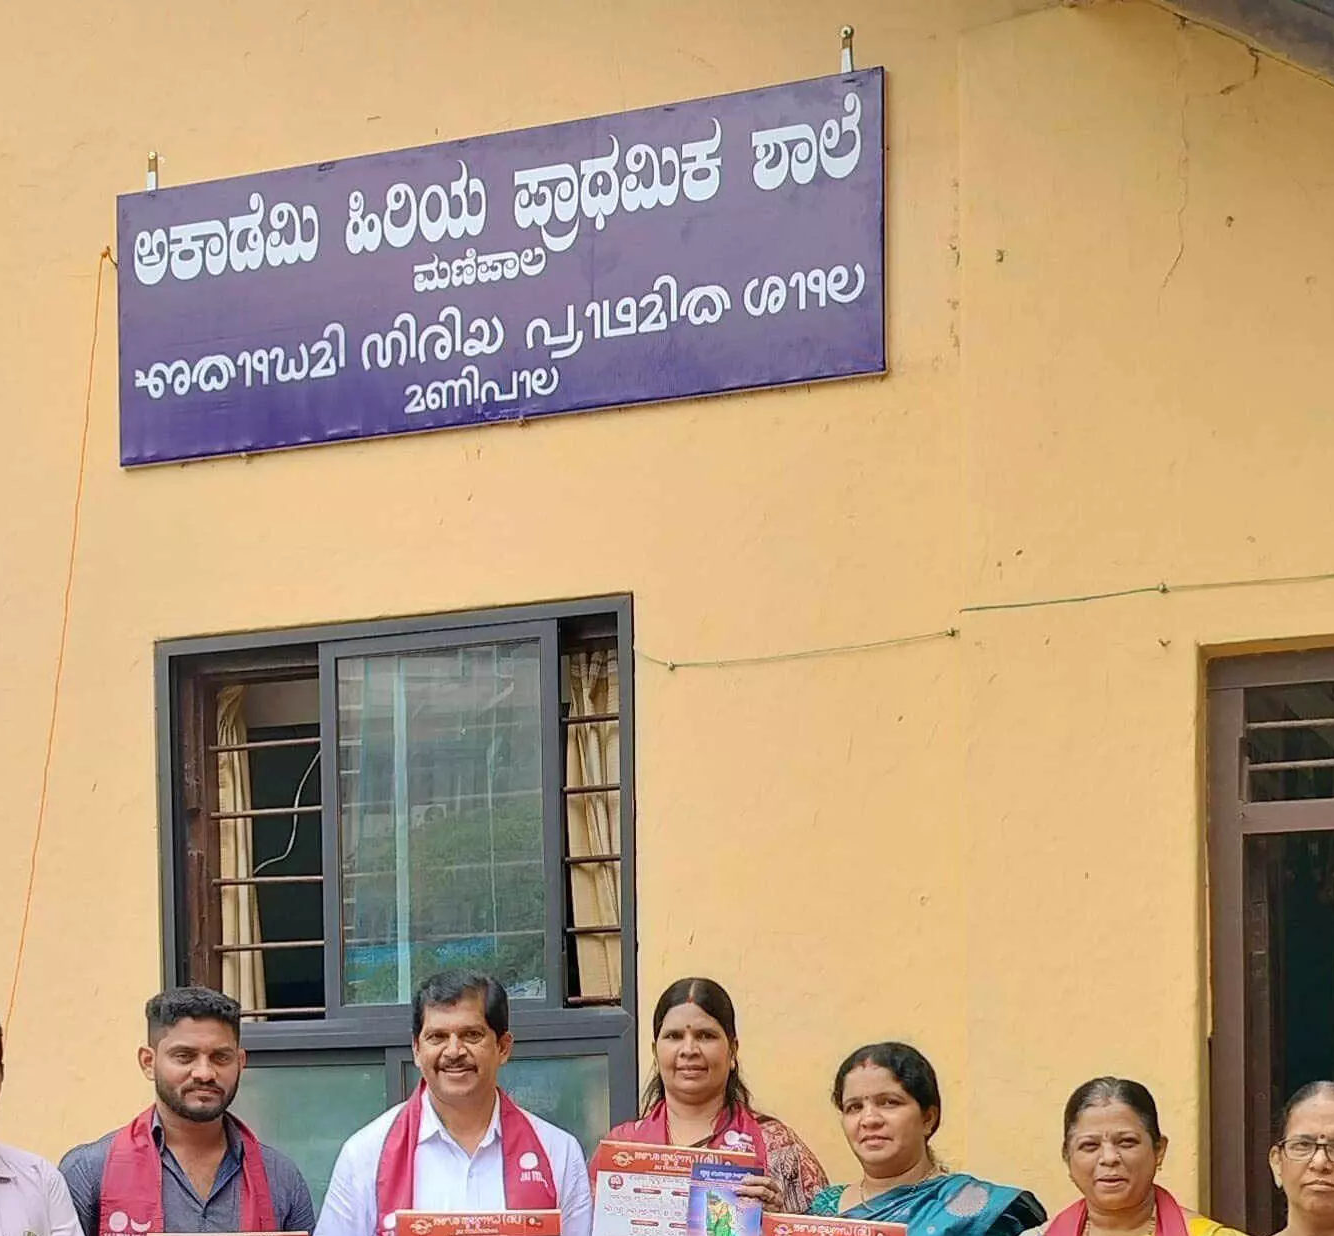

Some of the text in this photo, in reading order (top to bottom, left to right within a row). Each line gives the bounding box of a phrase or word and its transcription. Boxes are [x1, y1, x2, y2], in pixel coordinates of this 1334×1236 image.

[133, 91, 865, 285] ಅಕಾಡೆಮಿ ಹಿರಿಯ ಪ್ರಾಥಮಿಕ ಶಾಲೆ
[412, 249, 548, 293] ಮಣಿಪಾಲ
